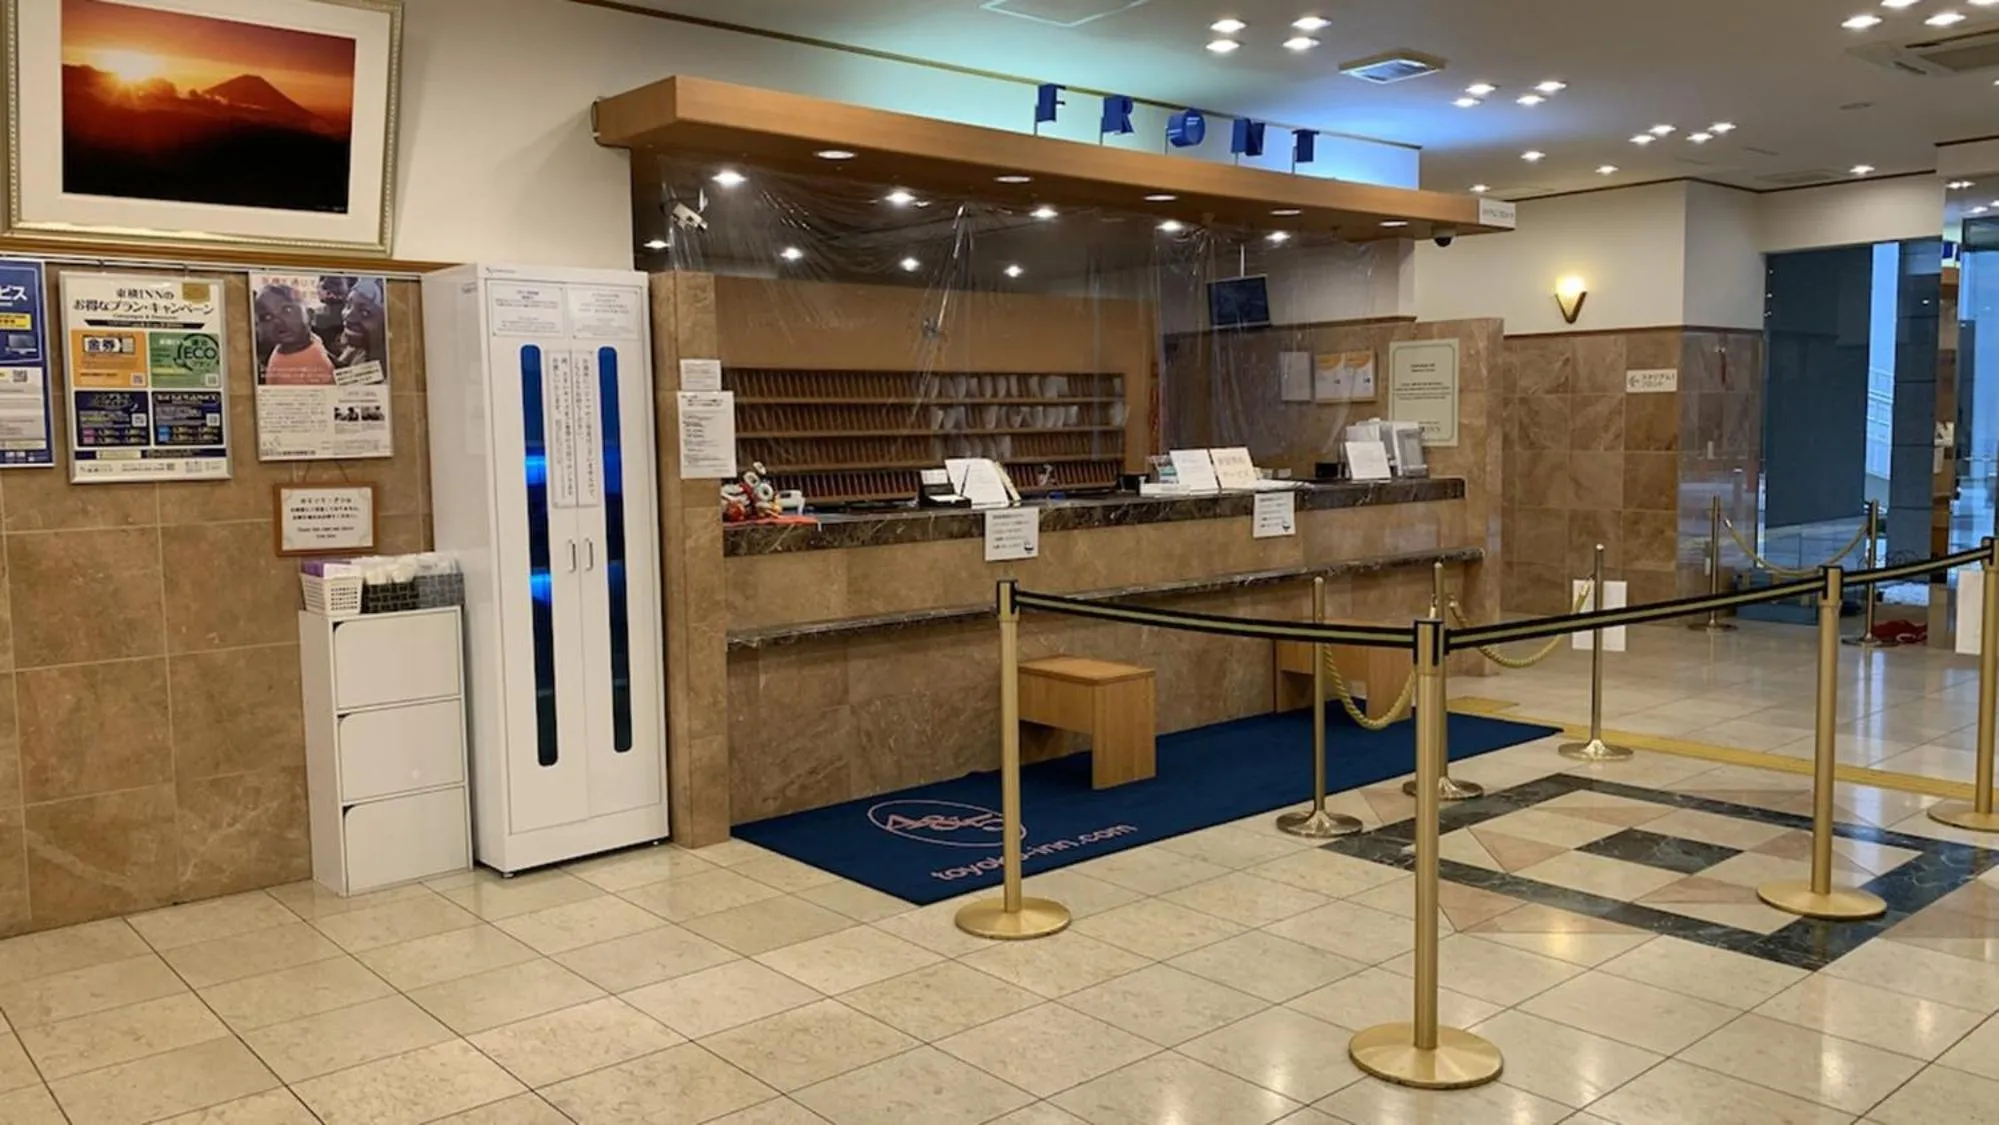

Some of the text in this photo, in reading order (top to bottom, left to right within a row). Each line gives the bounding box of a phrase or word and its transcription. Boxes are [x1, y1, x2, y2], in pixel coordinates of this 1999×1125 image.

[1036, 83, 1319, 163] FRONT
[116, 288, 174, 300] 東横INNの
[73, 298, 214, 315] お得なプラン・キャンペーン
[184, 346, 217, 360] ECO
[931, 823, 1138, 881] toyok-inn.com
